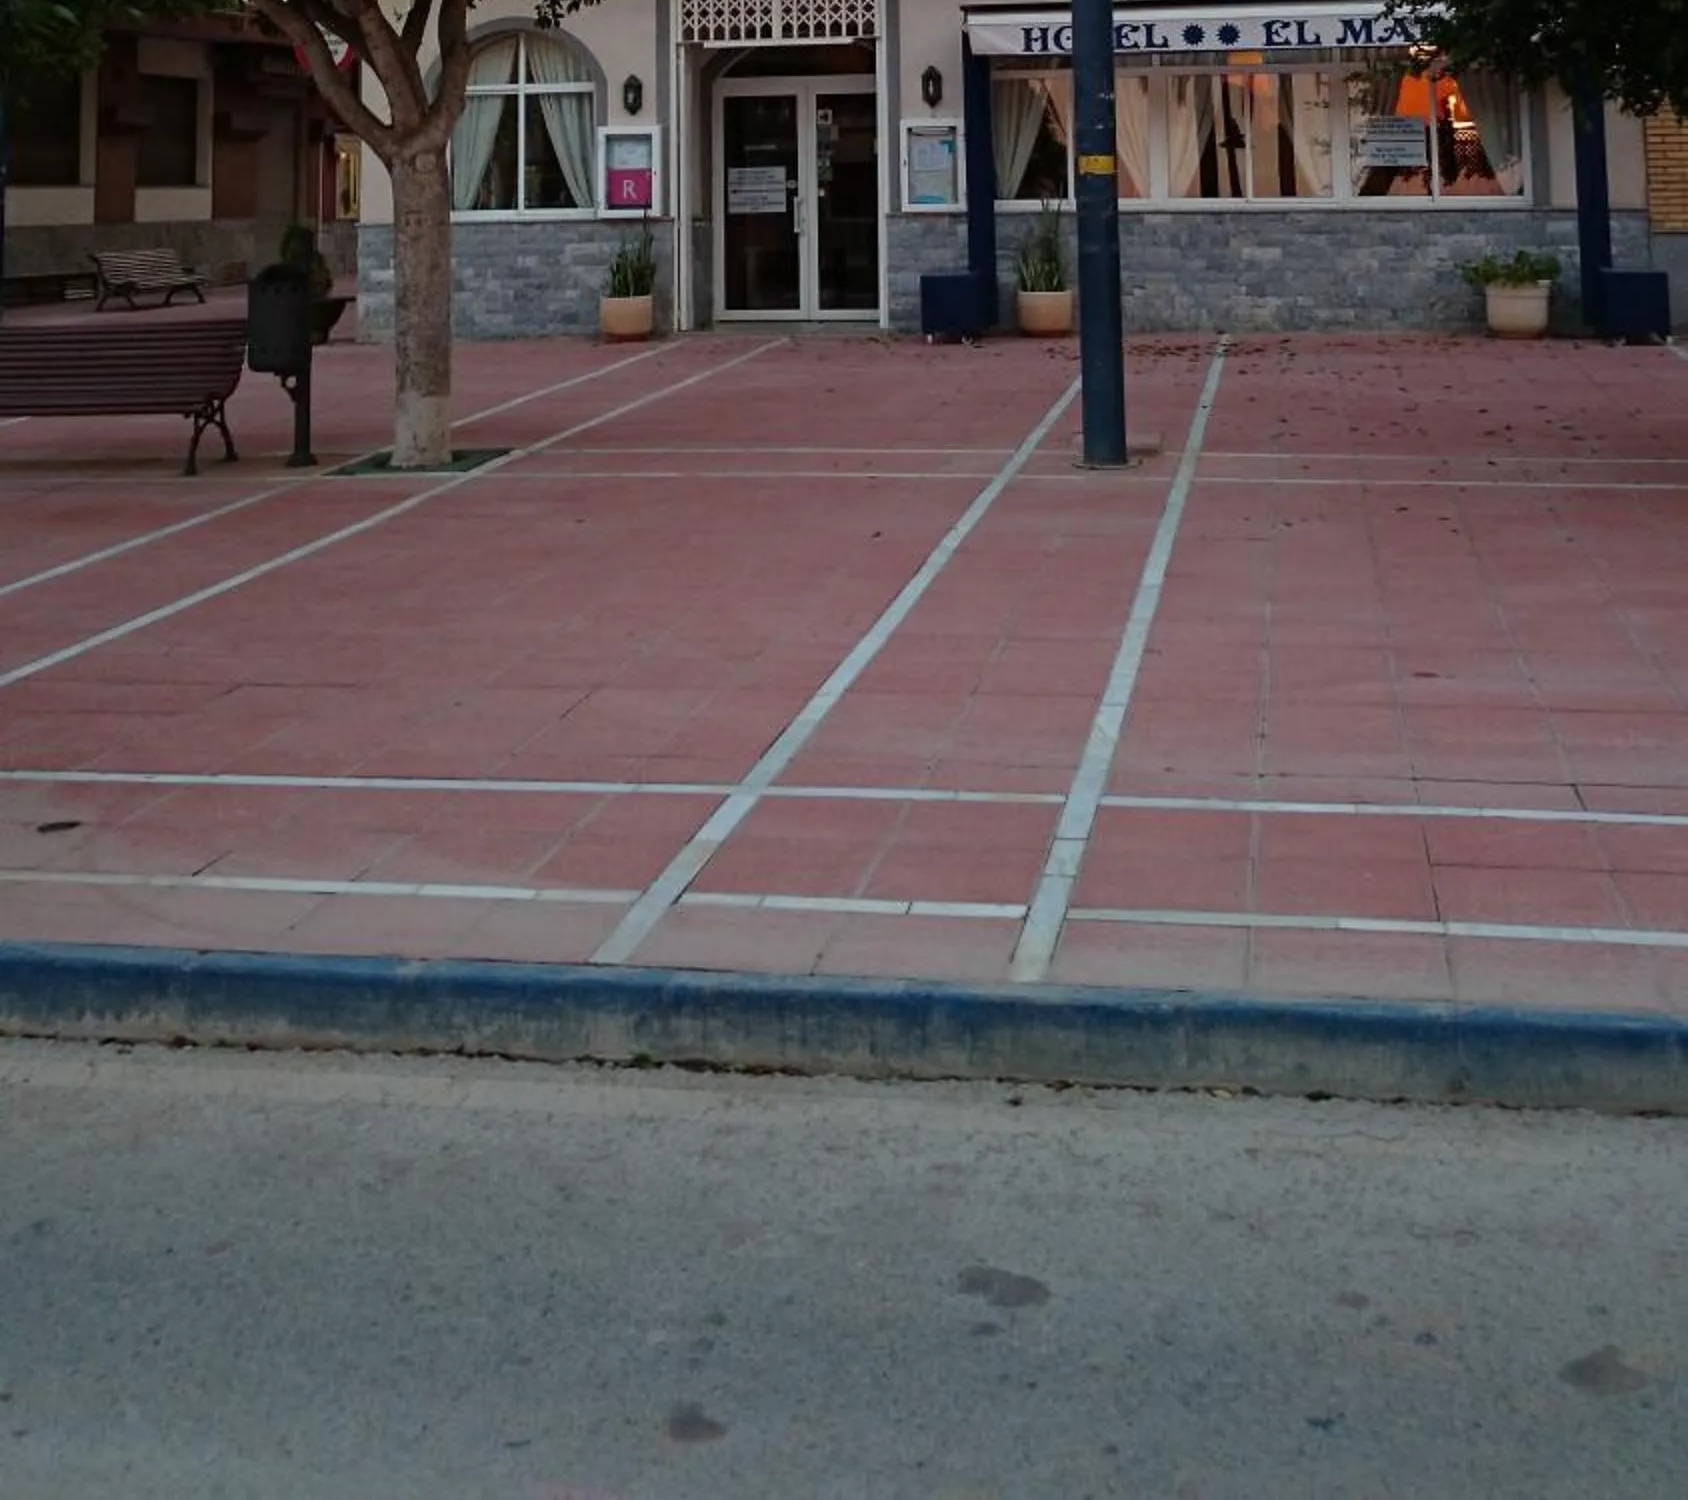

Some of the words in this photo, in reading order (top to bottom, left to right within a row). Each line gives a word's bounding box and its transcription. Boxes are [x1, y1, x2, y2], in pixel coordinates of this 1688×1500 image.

[1021, 23, 1169, 52] HOEL
[1262, 19, 1322, 46] EL
[622, 179, 638, 200] R
